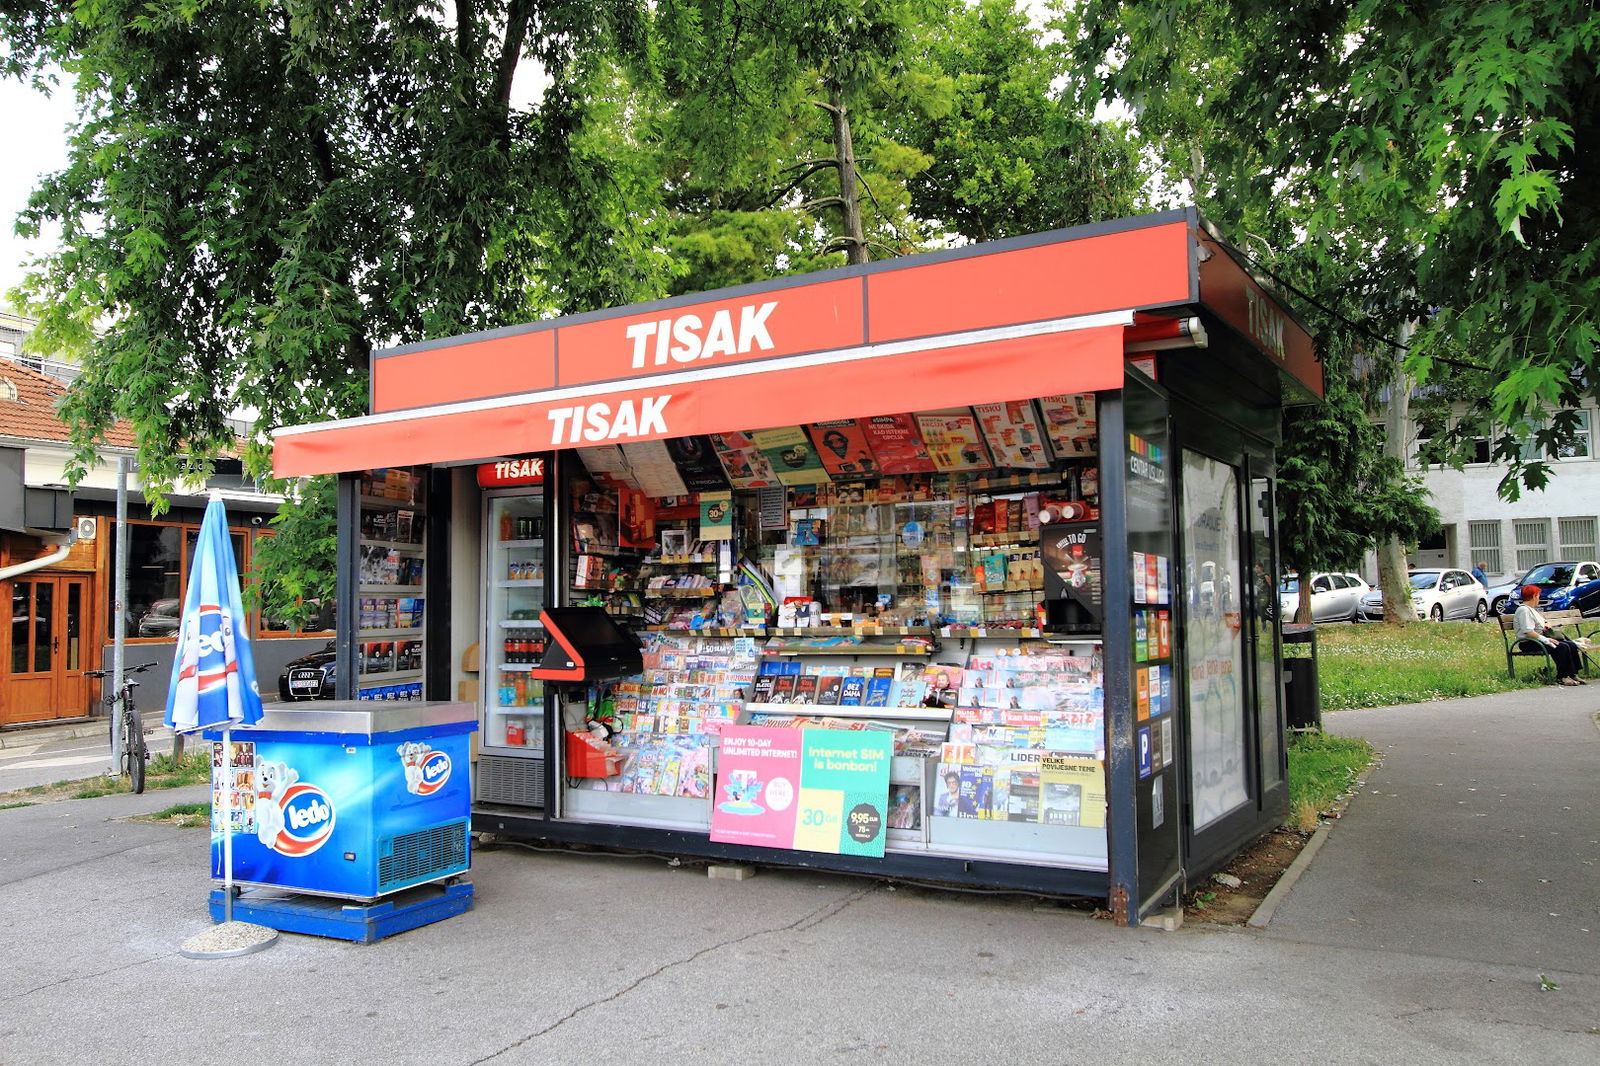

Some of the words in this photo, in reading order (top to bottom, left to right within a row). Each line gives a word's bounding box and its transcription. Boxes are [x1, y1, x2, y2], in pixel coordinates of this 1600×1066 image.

[625, 301, 779, 370] TISAK
[547, 394, 673, 446] TISAK
[495, 459, 544, 479] TISAK
[709, 509, 718, 518] 30
[1069, 533, 1077, 544] TO
[1077, 533, 1087, 544] GO
[846, 683, 860, 691] BEZ
[723, 737, 746, 747] ENJOY
[747, 738, 772, 747] 10-DAY
[722, 746, 760, 757] UNLIMITED
[761, 749, 798, 759] INTERNET!
[808, 746, 857, 760] Internet
[860, 748, 884, 760] SIM
[1010, 753, 1040, 762] LIDER
[814, 758, 824, 769] is
[826, 759, 877, 772] bonbon!
[1042, 757, 1065, 765] VELIKE
[425, 759, 448, 780] ledo
[1042, 763, 1077, 772] POVIJESNE
[1078, 765, 1096, 773] TEME
[288, 799, 330, 830] ledo
[802, 808, 825, 826] 30
[850, 812, 870, 825] 9,95
